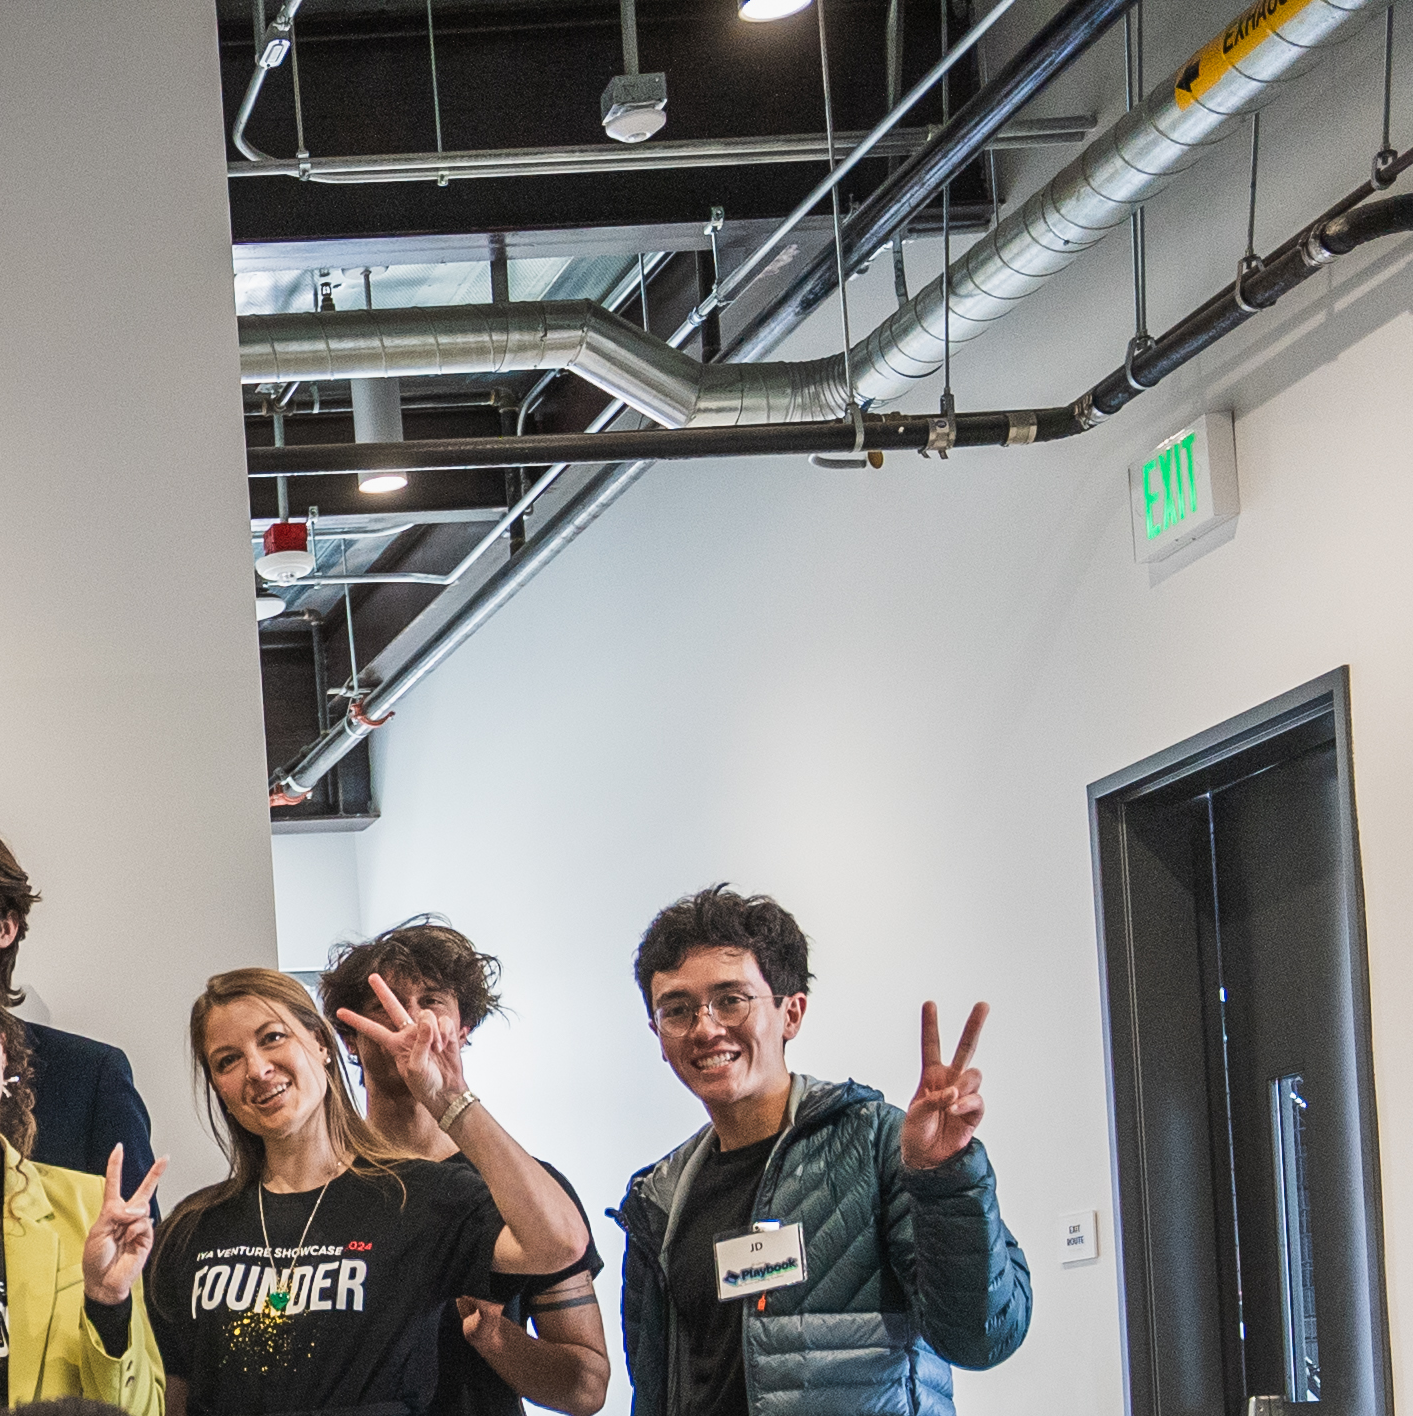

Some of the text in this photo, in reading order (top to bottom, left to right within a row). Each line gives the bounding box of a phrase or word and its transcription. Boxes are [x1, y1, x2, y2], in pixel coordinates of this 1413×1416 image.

[1142, 432, 1198, 540] EXIT
[196, 1240, 373, 1262] IYA VENTURE SHOWCASE 024
[750, 1241, 763, 1253] JD
[741, 1256, 799, 1280] Playbook
[191, 1258, 368, 1320] FOUNDER
